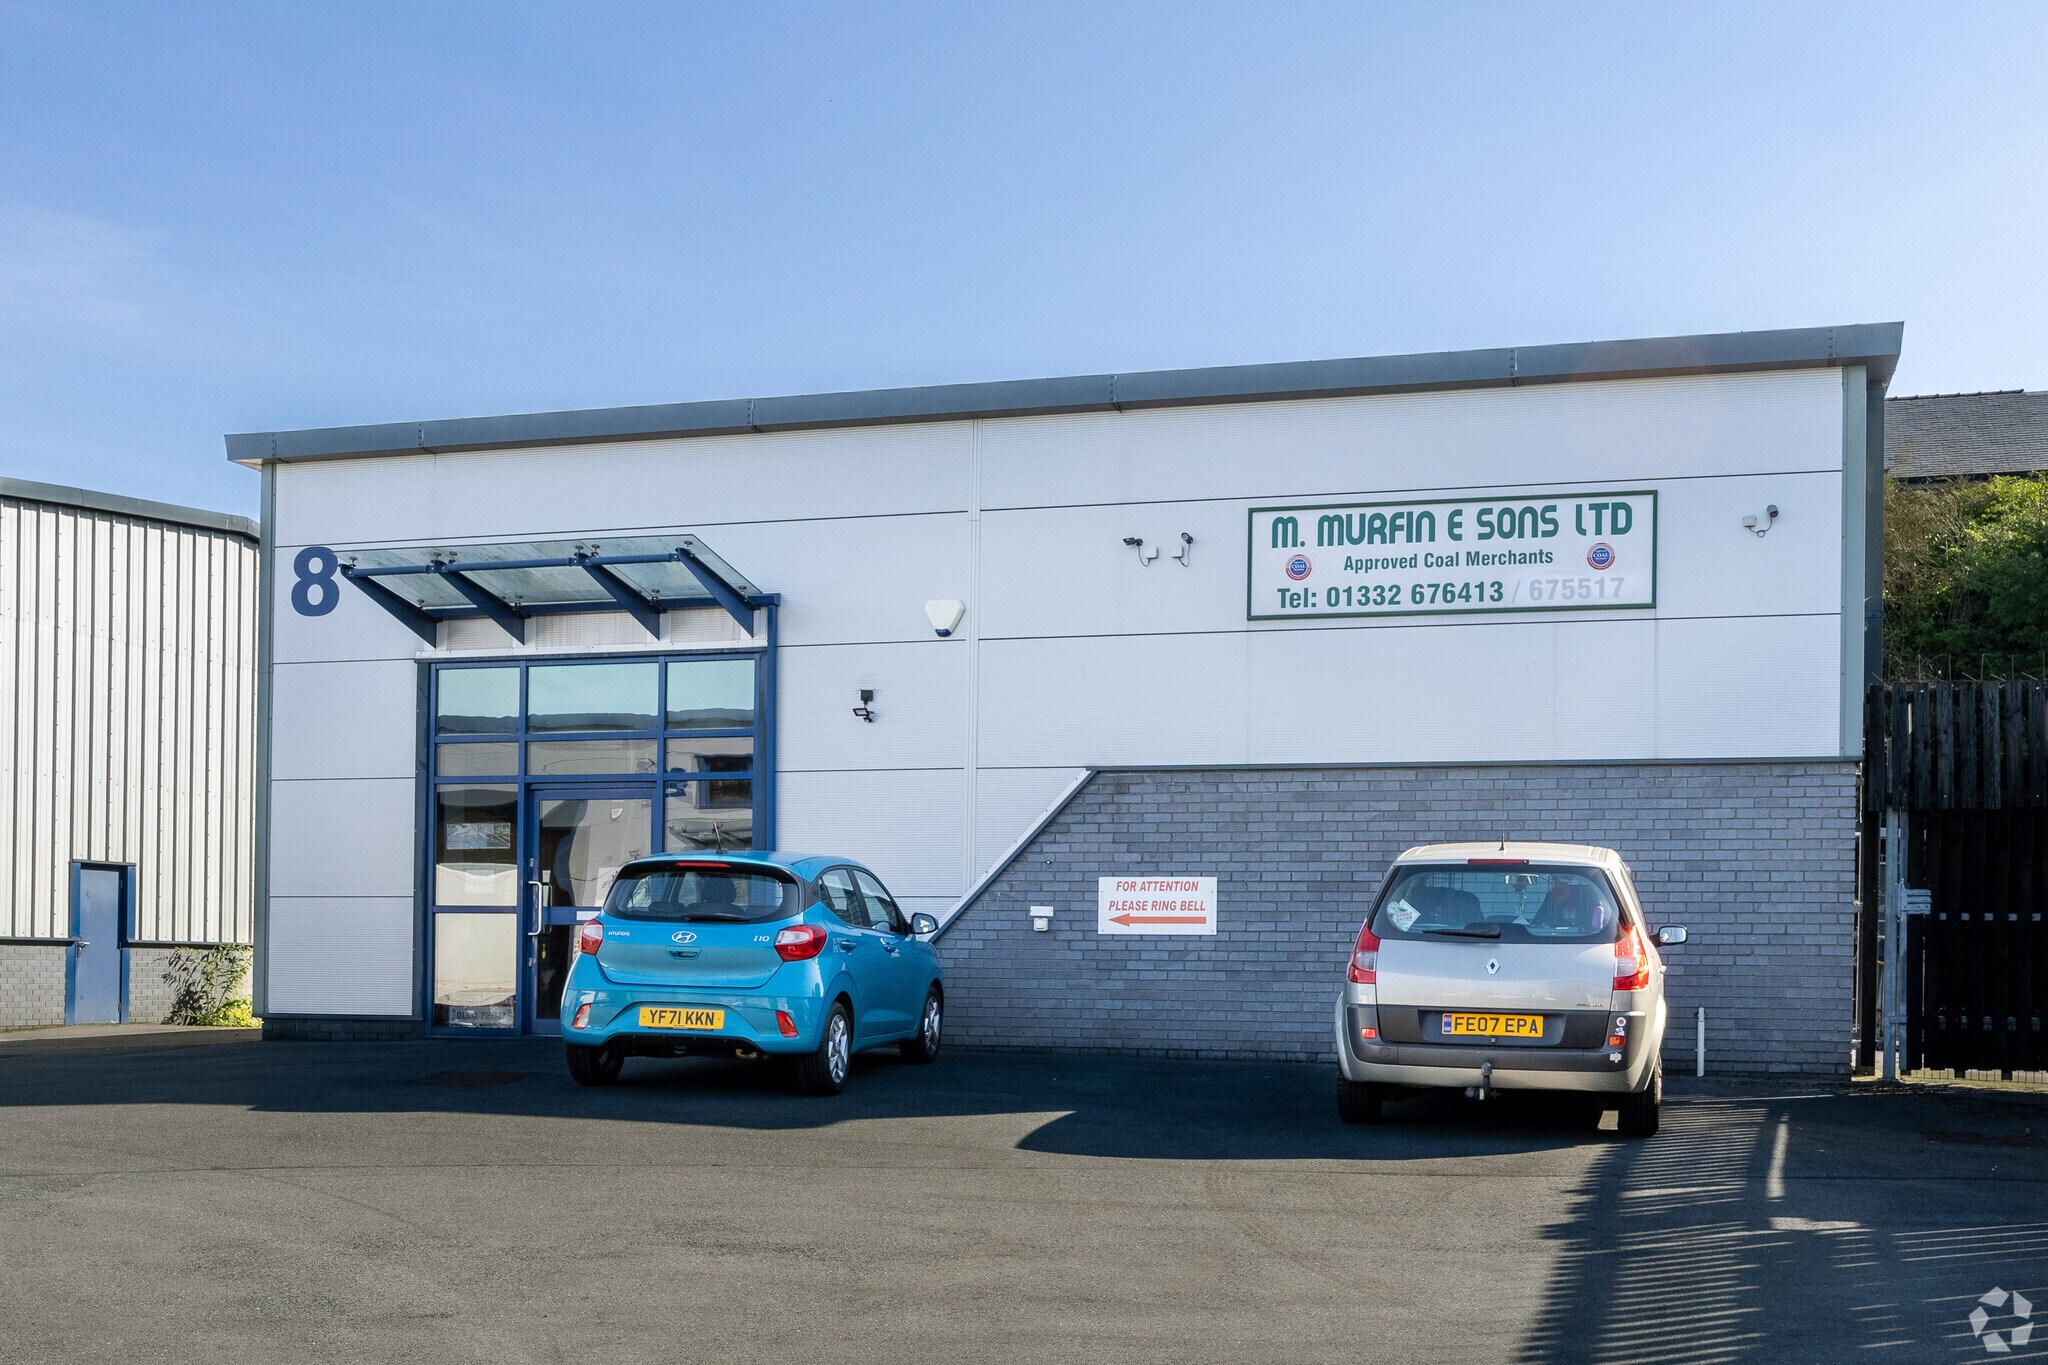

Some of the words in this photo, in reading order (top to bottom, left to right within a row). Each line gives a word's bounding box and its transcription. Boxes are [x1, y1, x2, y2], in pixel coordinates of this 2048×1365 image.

[1271, 515, 1306, 549] M.
[1317, 510, 1436, 547] MURFIN
[1477, 504, 1560, 540] SONS
[1576, 501, 1633, 537] LTD
[1344, 553, 1418, 574] Approved
[1424, 551, 1460, 569] Coal
[1466, 548, 1554, 568] Merchants
[291, 546, 340, 617] 8
[1277, 587, 1317, 609] Tel:
[1326, 584, 1402, 608] 01332
[1410, 580, 1504, 606] 676413
[1528, 576, 1625, 602] 675517
[1116, 881, 1137, 892] FOR
[1139, 881, 1199, 892] ATTENTION
[1108, 900, 1148, 911] PLEASE
[1151, 900, 1177, 911] RING
[1180, 900, 1206, 911] BELL
[649, 1009, 682, 1025] YF71
[685, 1011, 715, 1026] KKN
[1454, 1016, 1500, 1033] FE07
[1504, 1017, 1539, 1034] EPA
